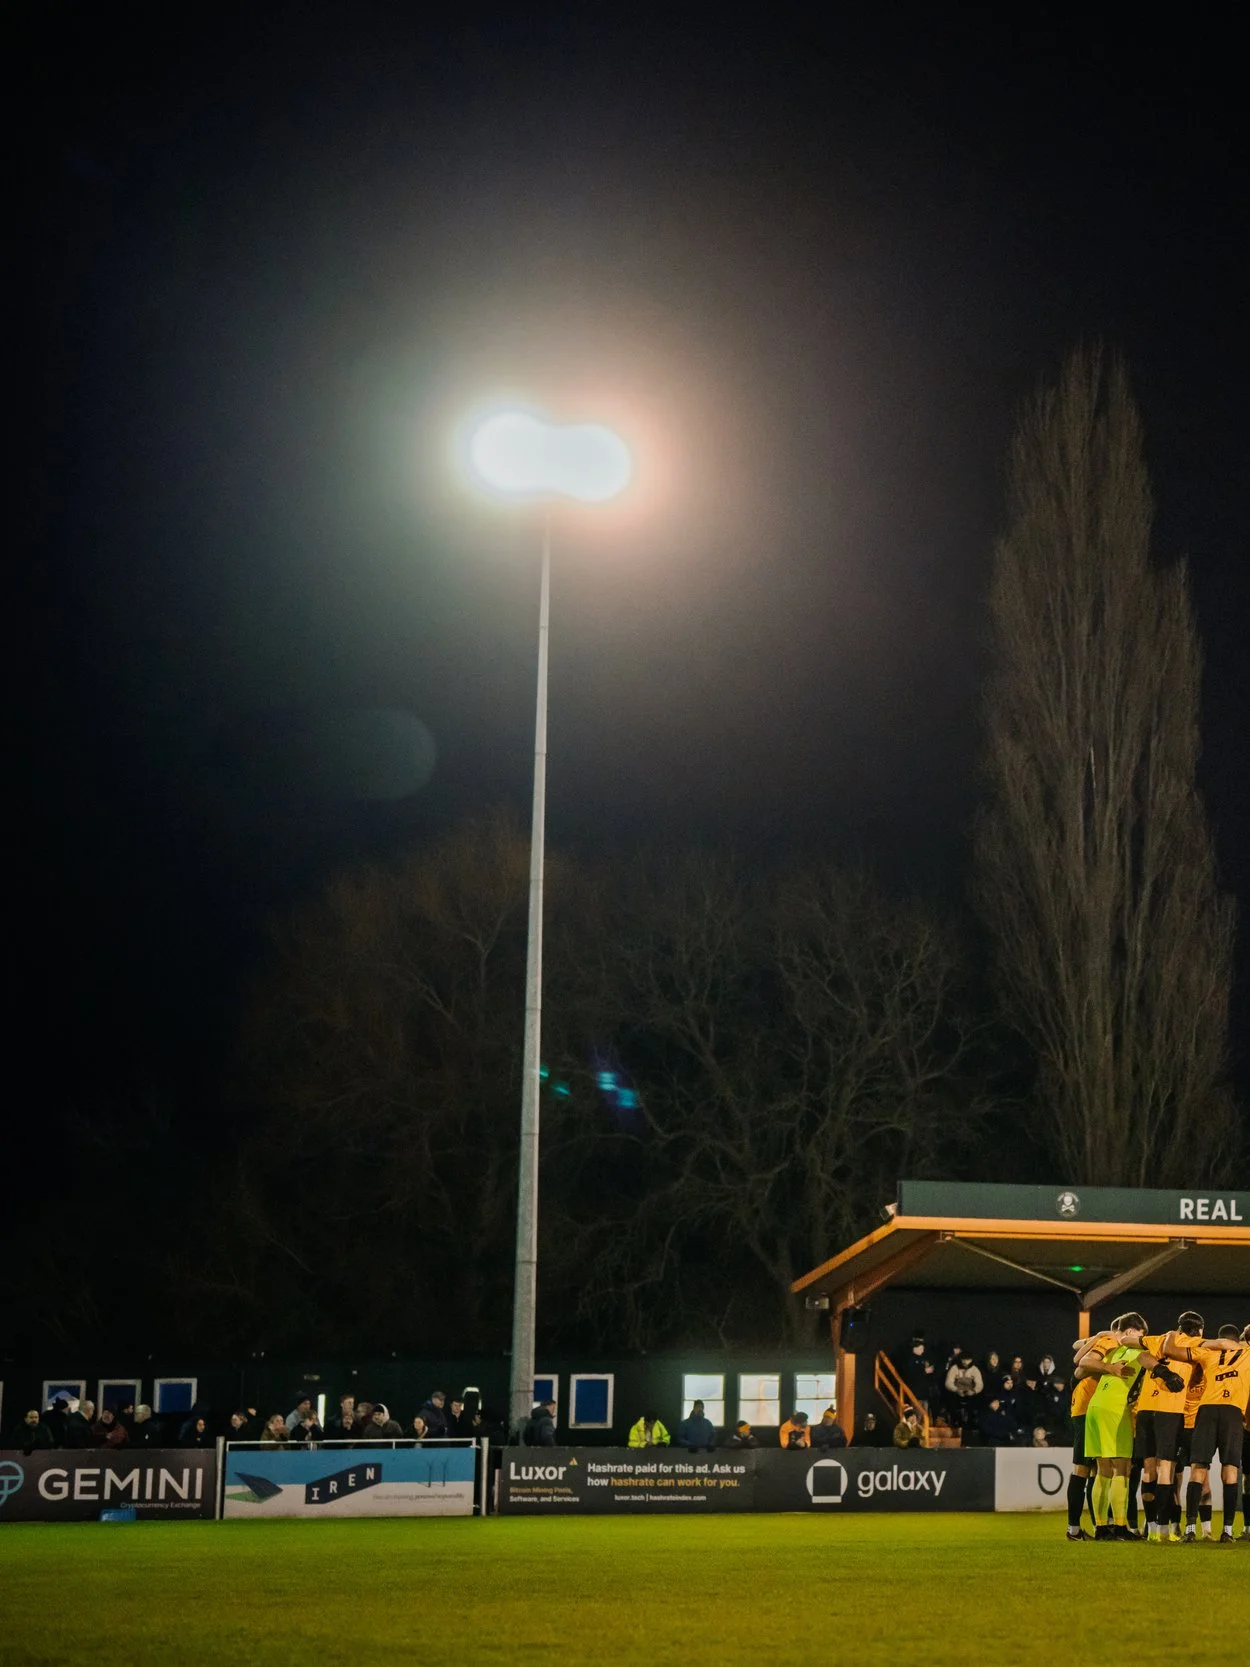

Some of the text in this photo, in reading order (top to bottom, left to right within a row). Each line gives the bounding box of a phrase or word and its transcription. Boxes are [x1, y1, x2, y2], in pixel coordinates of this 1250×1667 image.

[1180, 1198, 1243, 1221] REAL
[509, 1462, 567, 1481] Luxor
[587, 1463, 746, 1475] Hashrate paid for this ad. Ask us
[38, 1468, 203, 1501] GEMINI
[312, 1467, 375, 1501] IREN
[587, 1476, 739, 1489] how hashrate can work for you.
[857, 1464, 947, 1498] galaxy
[120, 1502, 169, 1510] Cryptocurrency
